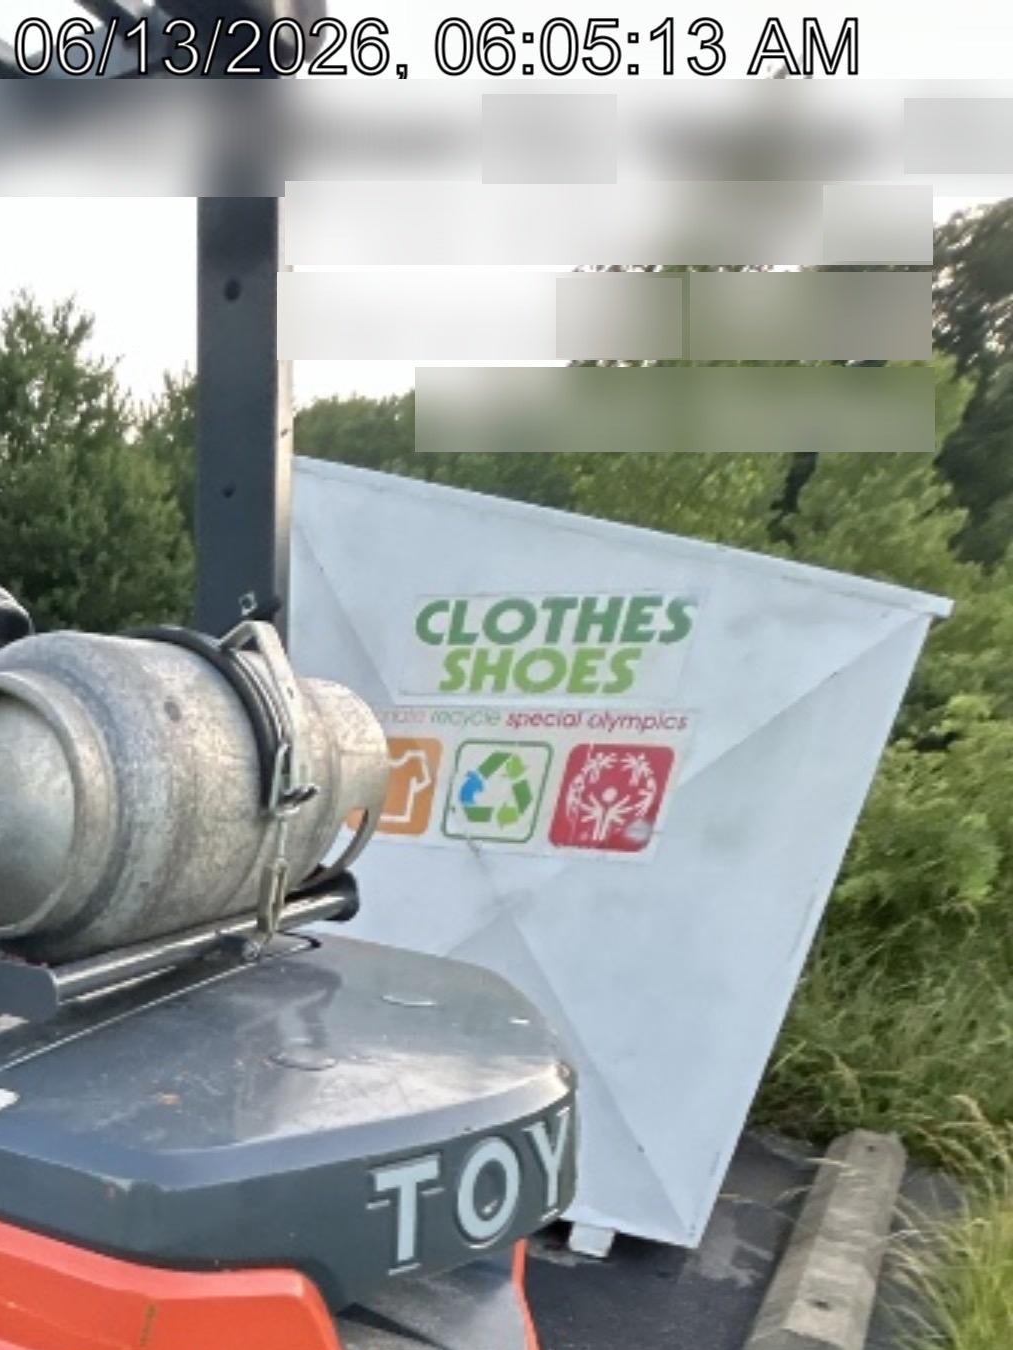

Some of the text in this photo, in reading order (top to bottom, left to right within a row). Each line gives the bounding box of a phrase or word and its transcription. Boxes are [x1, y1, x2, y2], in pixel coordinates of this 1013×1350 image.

[415, 596, 697, 646] CLOTHES
[439, 648, 642, 694] SHOES
[506, 710, 583, 730] special
[587, 709, 688, 733] olympics
